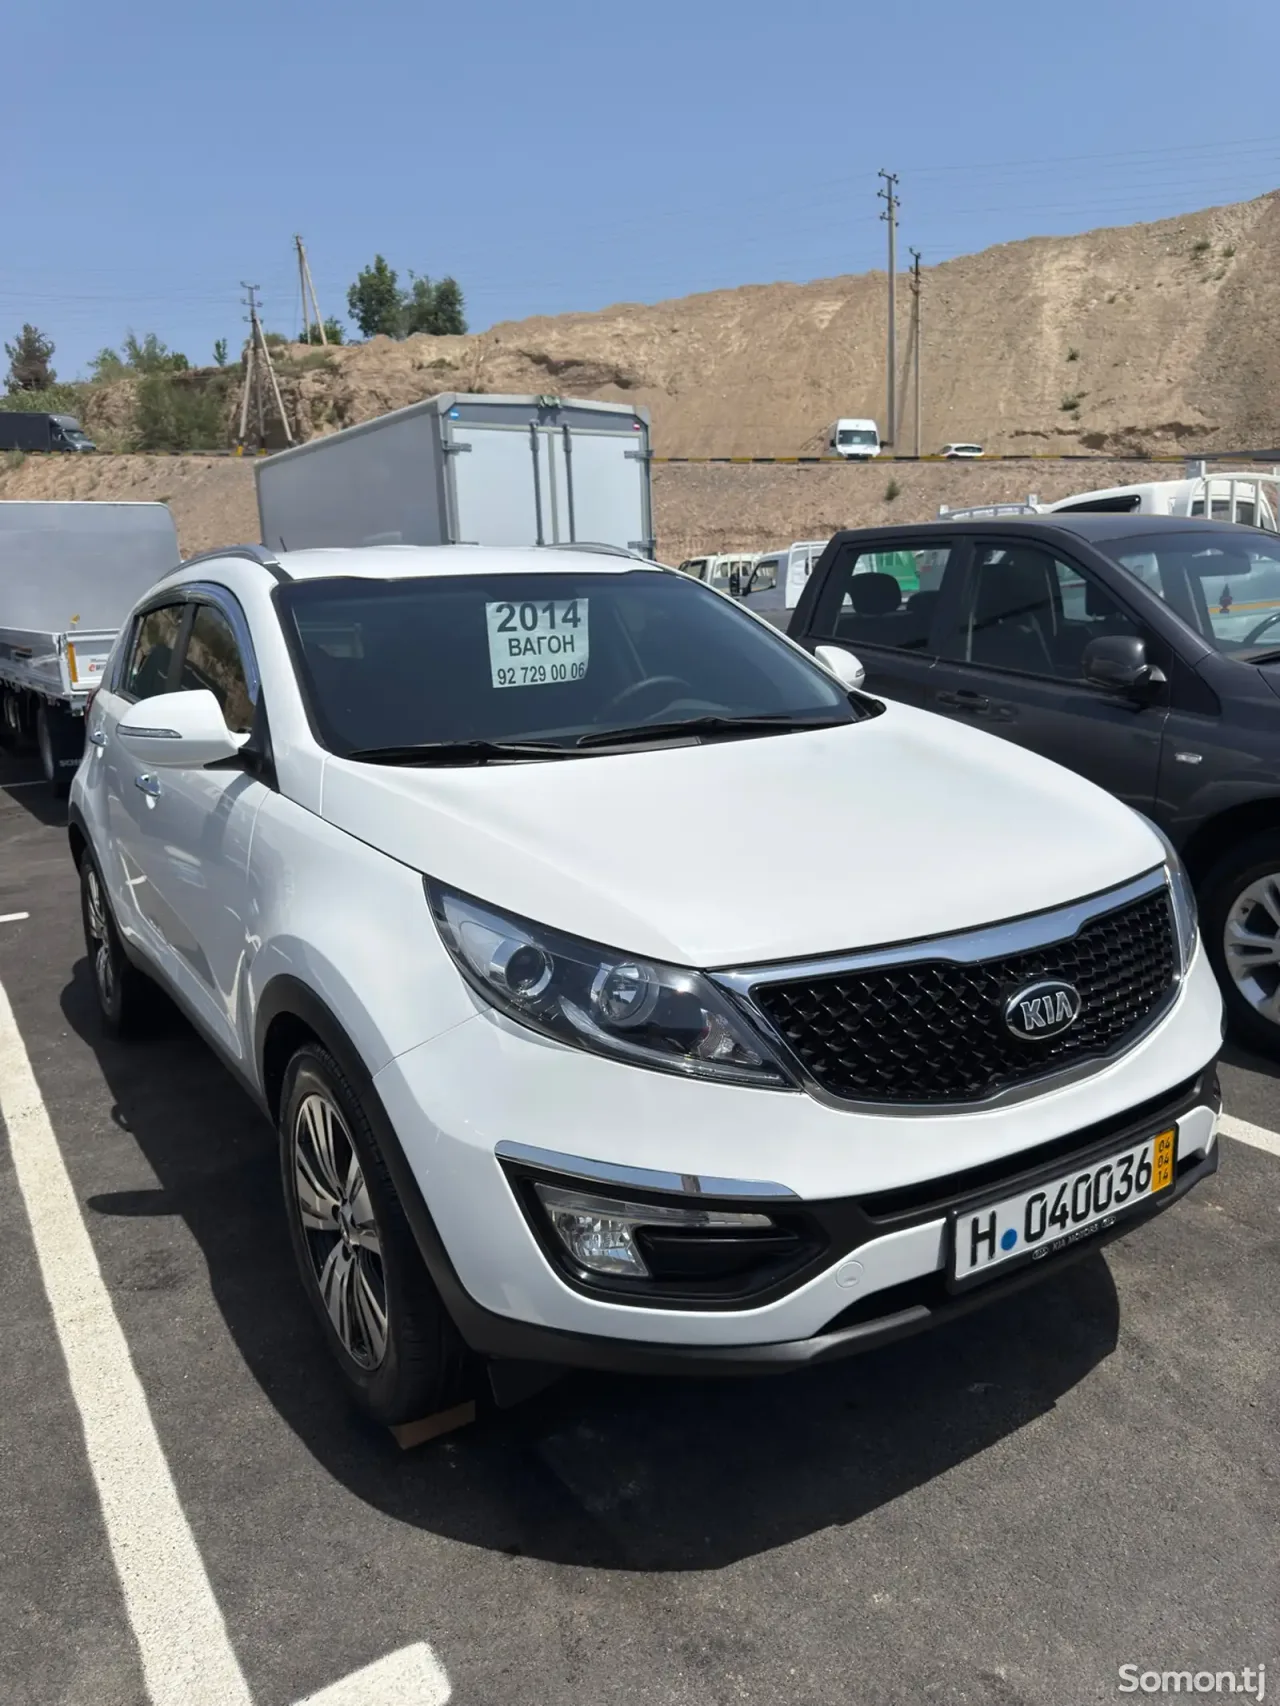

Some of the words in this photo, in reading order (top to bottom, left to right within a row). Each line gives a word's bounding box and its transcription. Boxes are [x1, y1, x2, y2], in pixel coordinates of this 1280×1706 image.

[495, 601, 581, 632] 2014
[508, 634, 575, 656] ВАГОН
[497, 668, 516, 685] 92
[521, 665, 546, 683] 729
[551, 664, 566, 681] 00
[571, 662, 585, 679] 06
[1020, 991, 1073, 1030] KIA
[1159, 1136, 1170, 1153] 04
[1158, 1152, 1169, 1168] 04
[1158, 1168, 1168, 1183] 14
[970, 1210, 997, 1267] H
[1024, 1146, 1153, 1244] 040036
